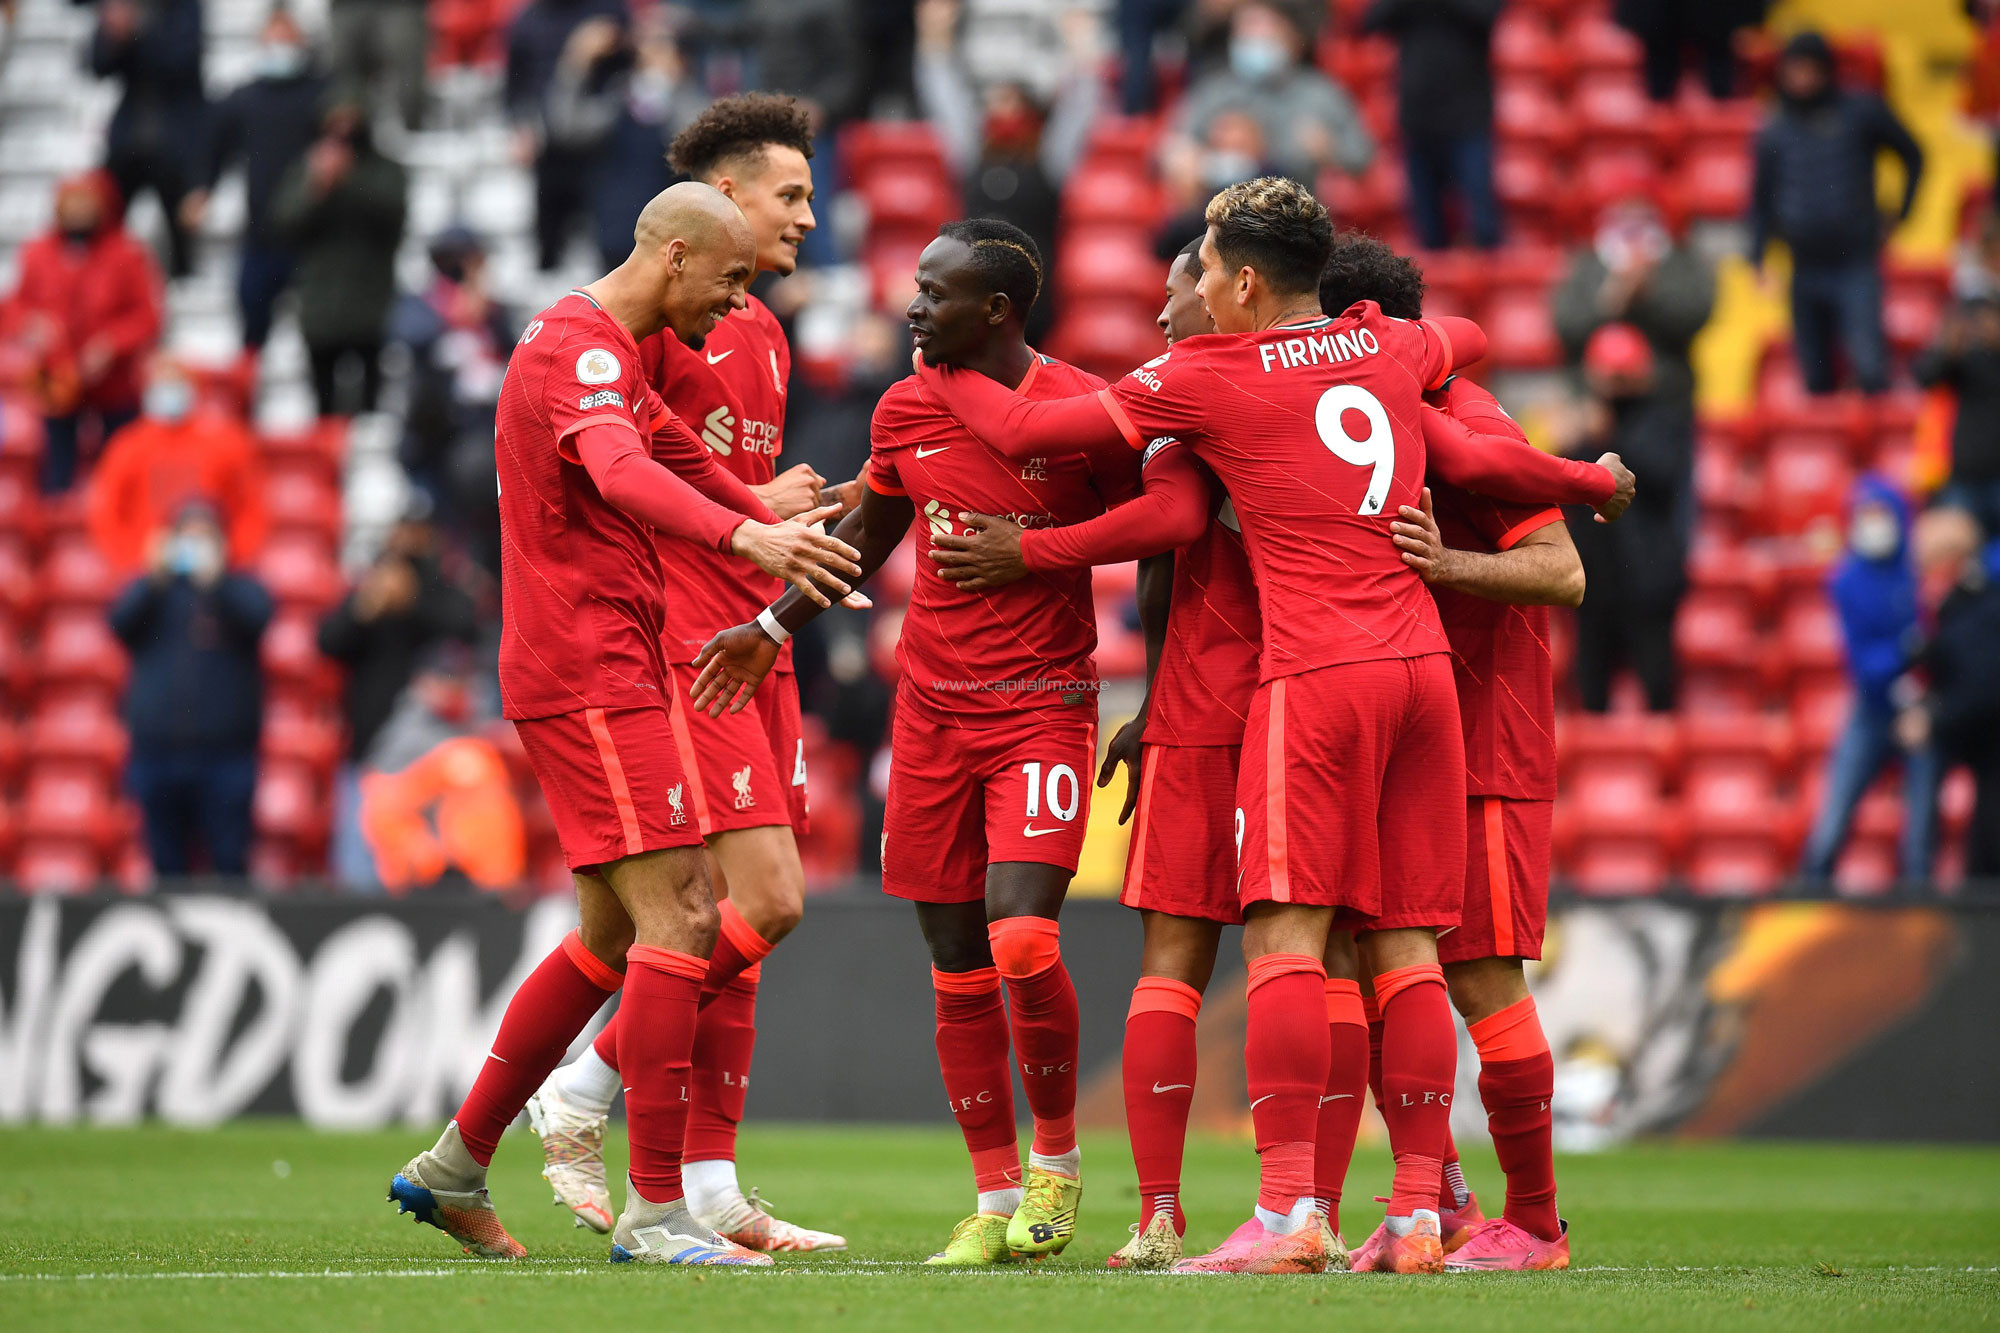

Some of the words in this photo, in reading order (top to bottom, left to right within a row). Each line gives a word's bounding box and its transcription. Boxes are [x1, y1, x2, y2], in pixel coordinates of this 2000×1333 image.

[1259, 327, 1379, 373] FIRMINO
[595, 391, 619, 402] room
[1127, 368, 1163, 392] edia
[1315, 384, 1395, 515] 9
[1022, 762, 1079, 821] 10
